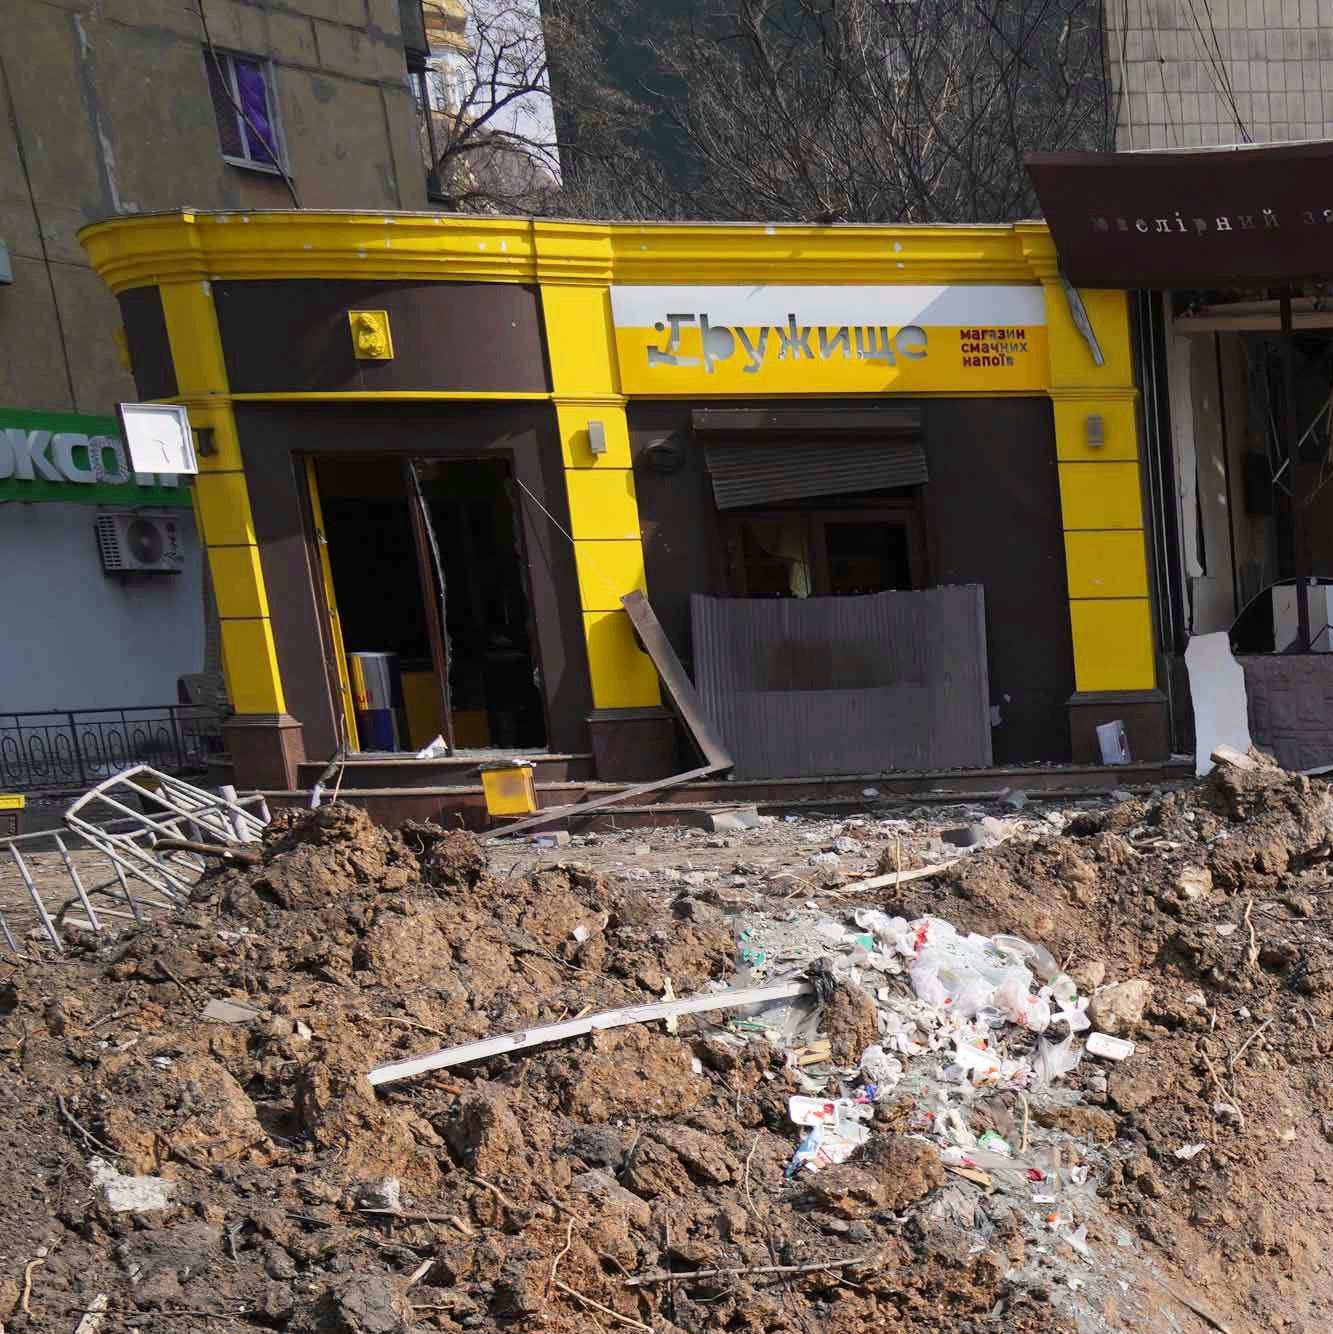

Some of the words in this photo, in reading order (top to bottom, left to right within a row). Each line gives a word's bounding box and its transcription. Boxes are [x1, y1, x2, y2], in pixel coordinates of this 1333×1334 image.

[959, 328, 1025, 340] магазин
[646, 312, 929, 374] Дружище
[961, 342, 1029, 353] смачних
[962, 353, 1015, 367] напоїв
